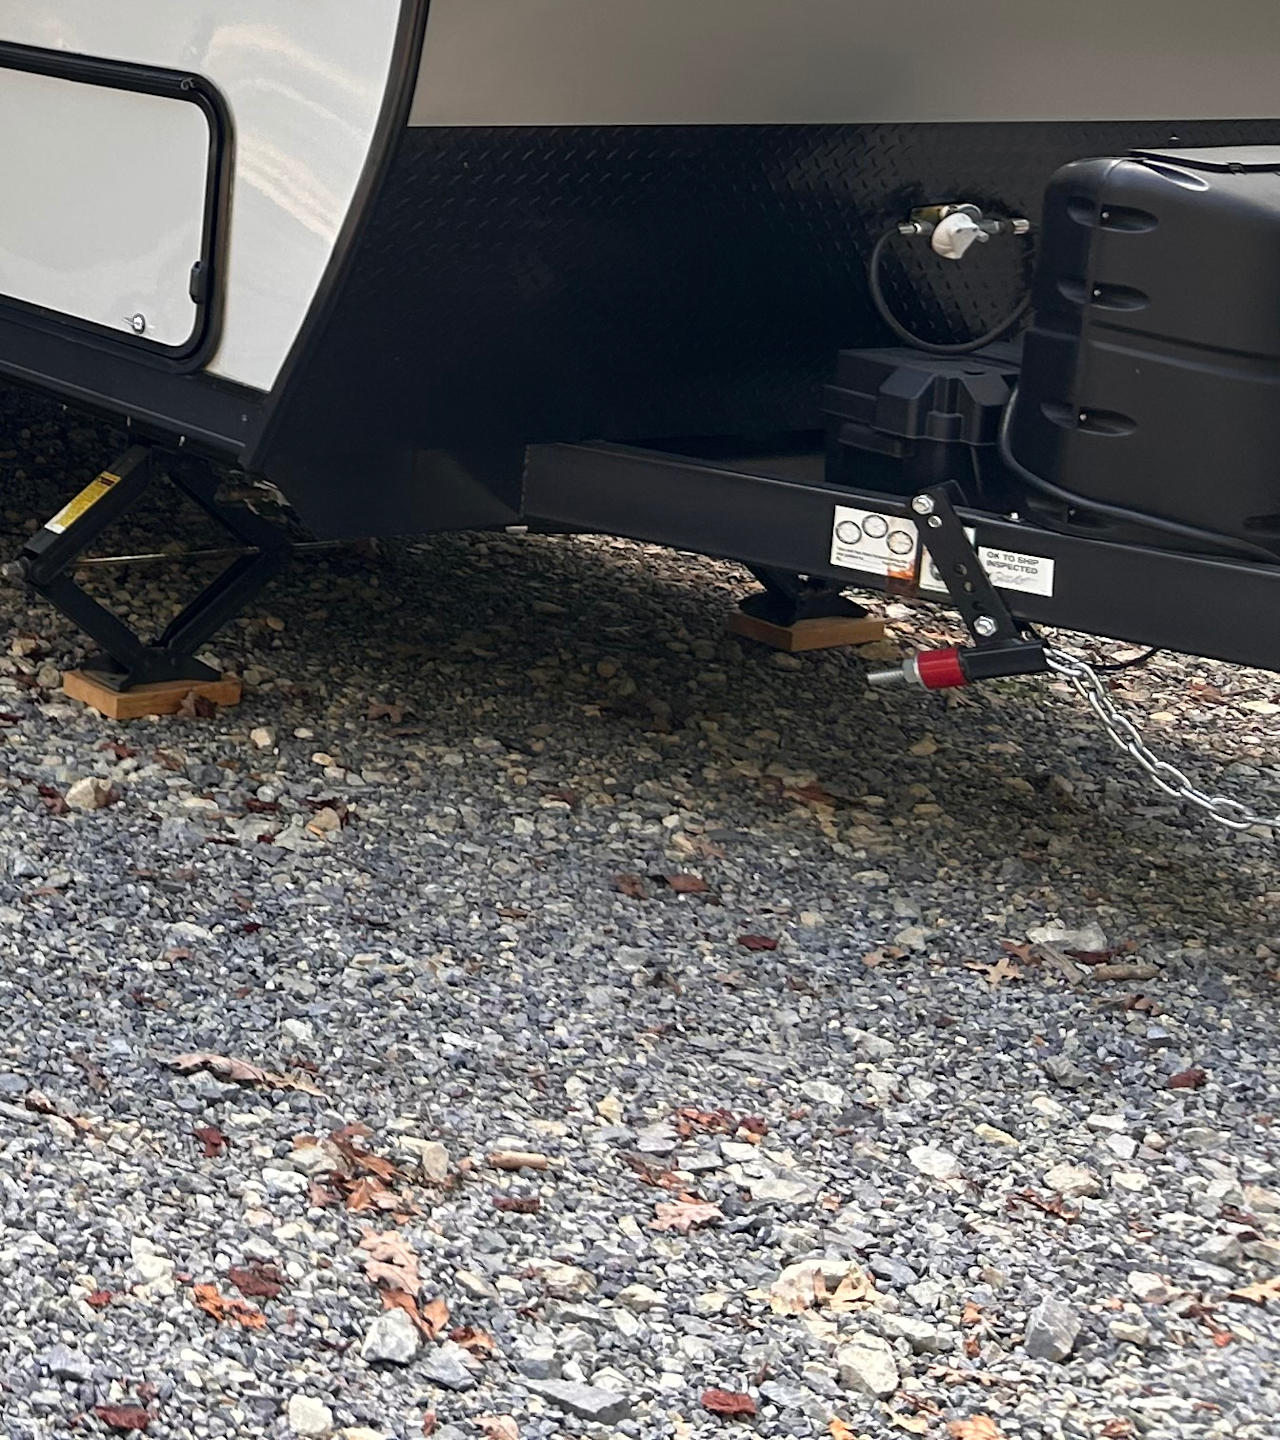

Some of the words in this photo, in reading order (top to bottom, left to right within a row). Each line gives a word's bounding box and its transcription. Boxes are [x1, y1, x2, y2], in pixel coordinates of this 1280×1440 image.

[986, 551, 1000, 560] OK
[1002, 553, 1016, 563] TO
[986, 559, 1039, 575] INSPECTED
